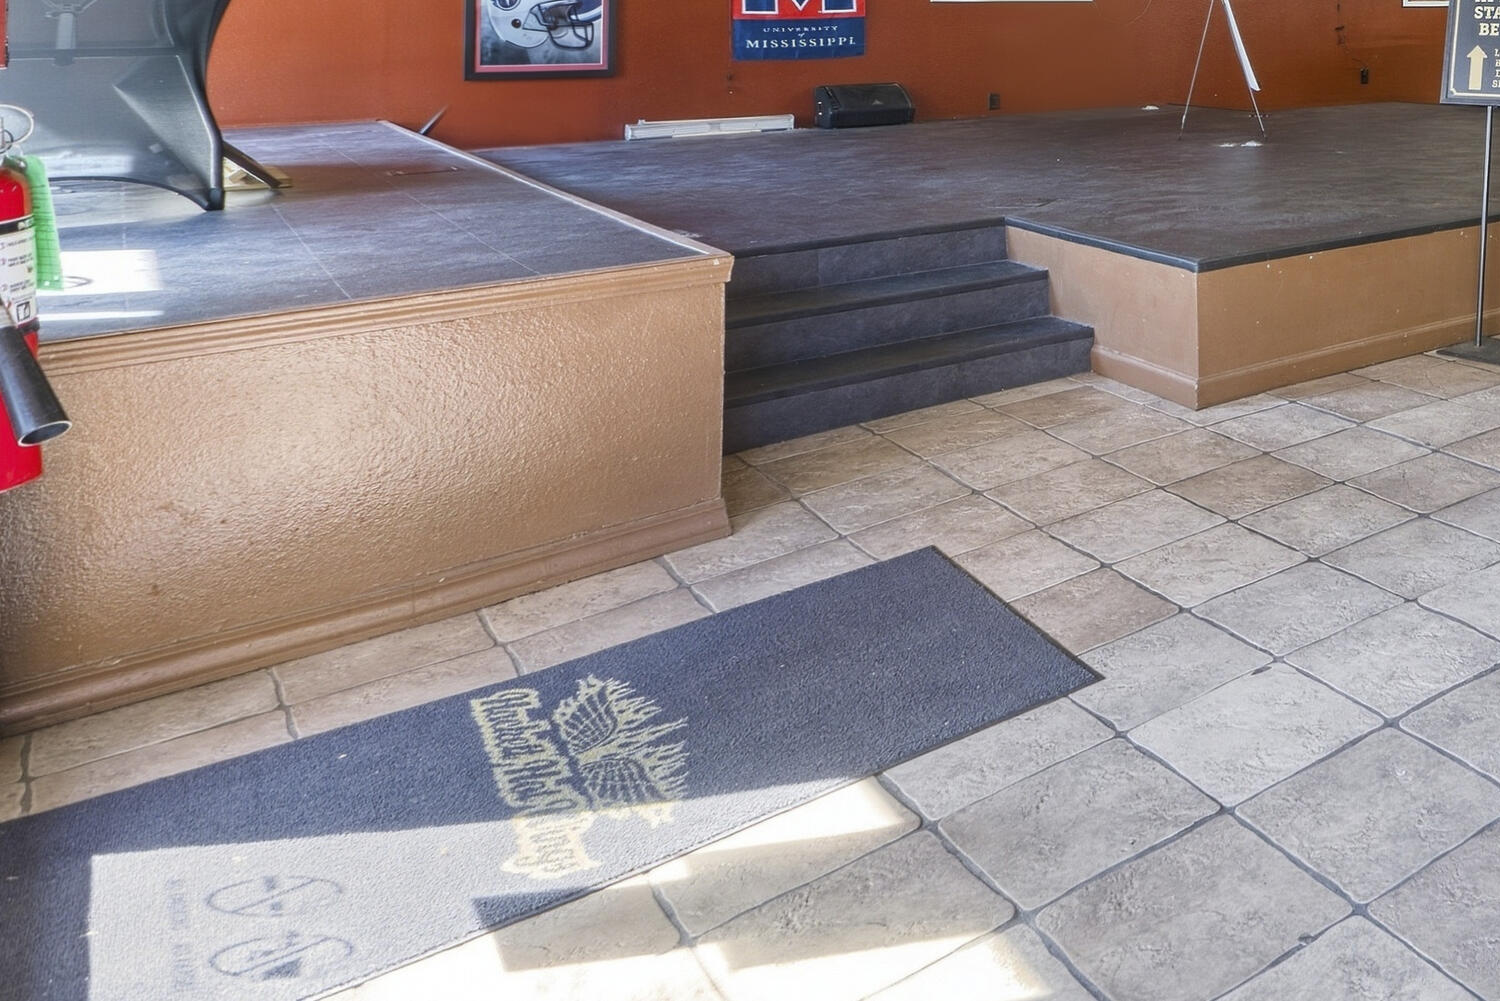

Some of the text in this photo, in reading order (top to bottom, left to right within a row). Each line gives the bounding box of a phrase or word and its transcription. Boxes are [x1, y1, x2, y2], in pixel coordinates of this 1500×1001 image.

[763, 25, 839, 33] UNIVERSITY
[1479, 23, 1499, 36] BE
[746, 36, 856, 49] MISSISSIPPI
